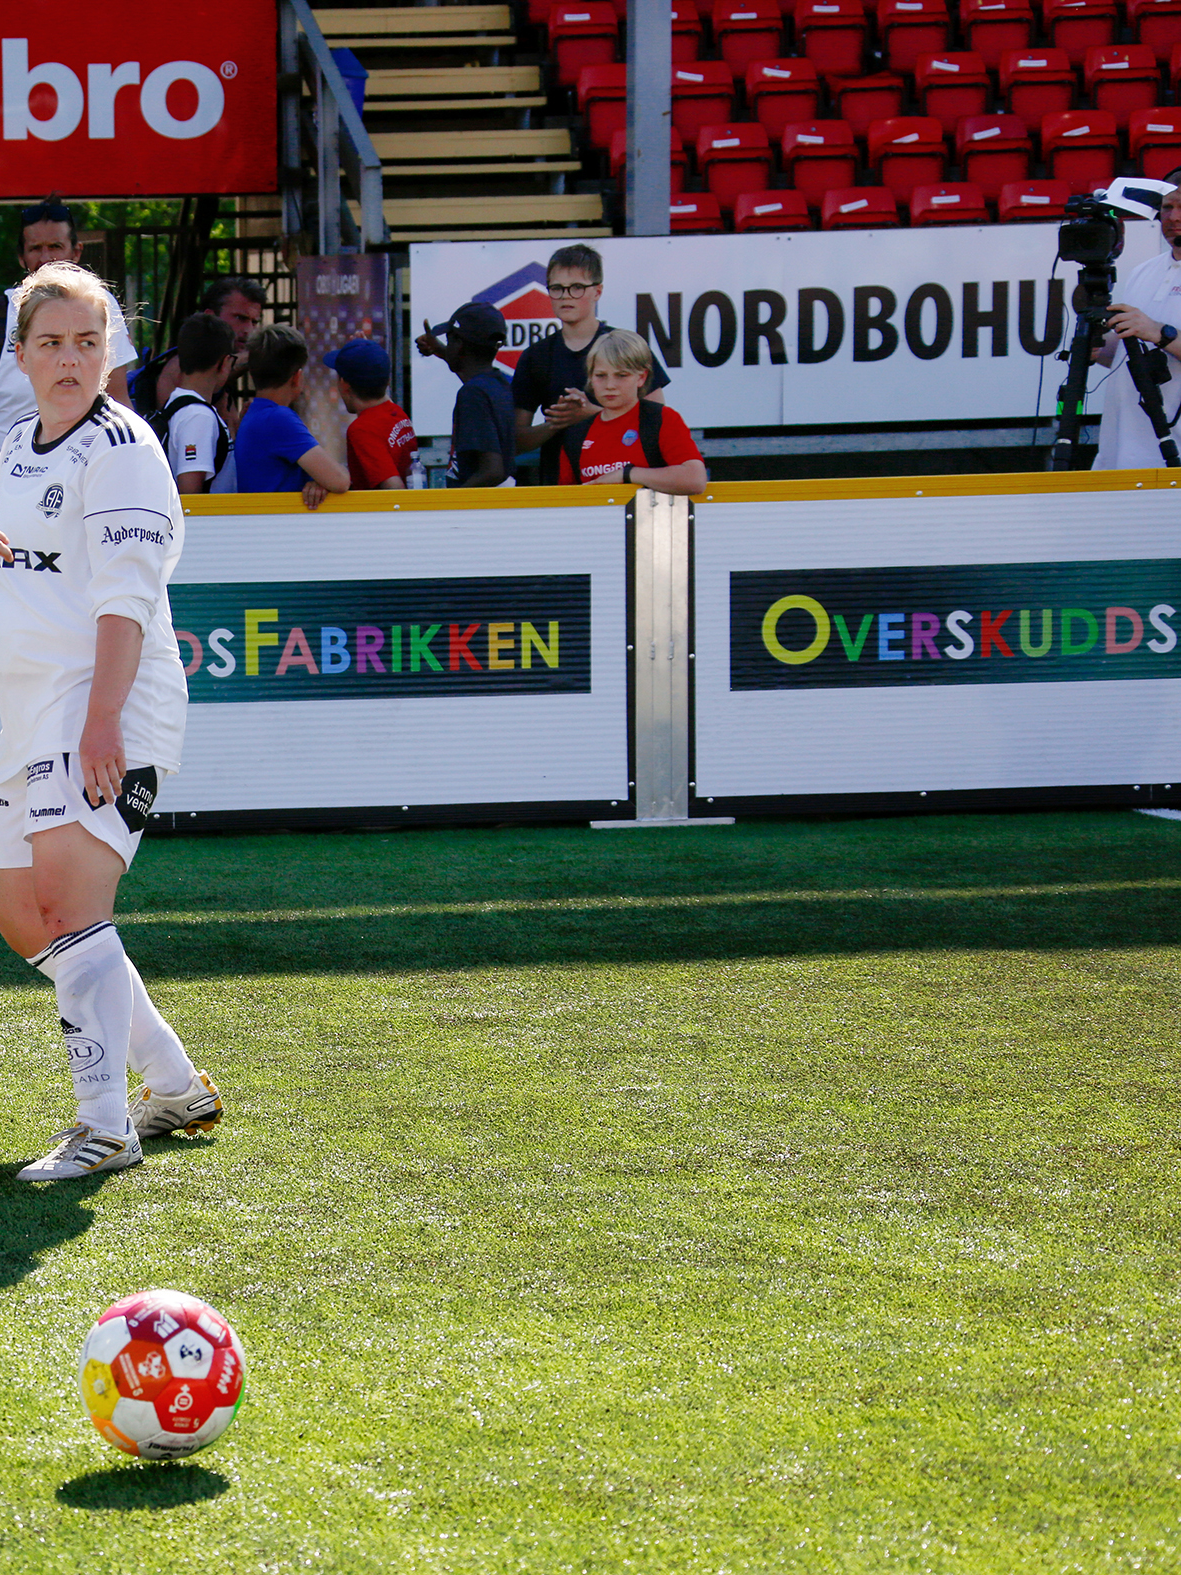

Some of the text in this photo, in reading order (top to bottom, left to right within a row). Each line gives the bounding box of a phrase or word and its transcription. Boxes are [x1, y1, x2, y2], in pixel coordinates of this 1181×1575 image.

[100, 525, 165, 546] Agderposte
[29, 805, 66, 819] hummel
[126, 793, 149, 818] vent
[147, 1442, 195, 1451] hummel
